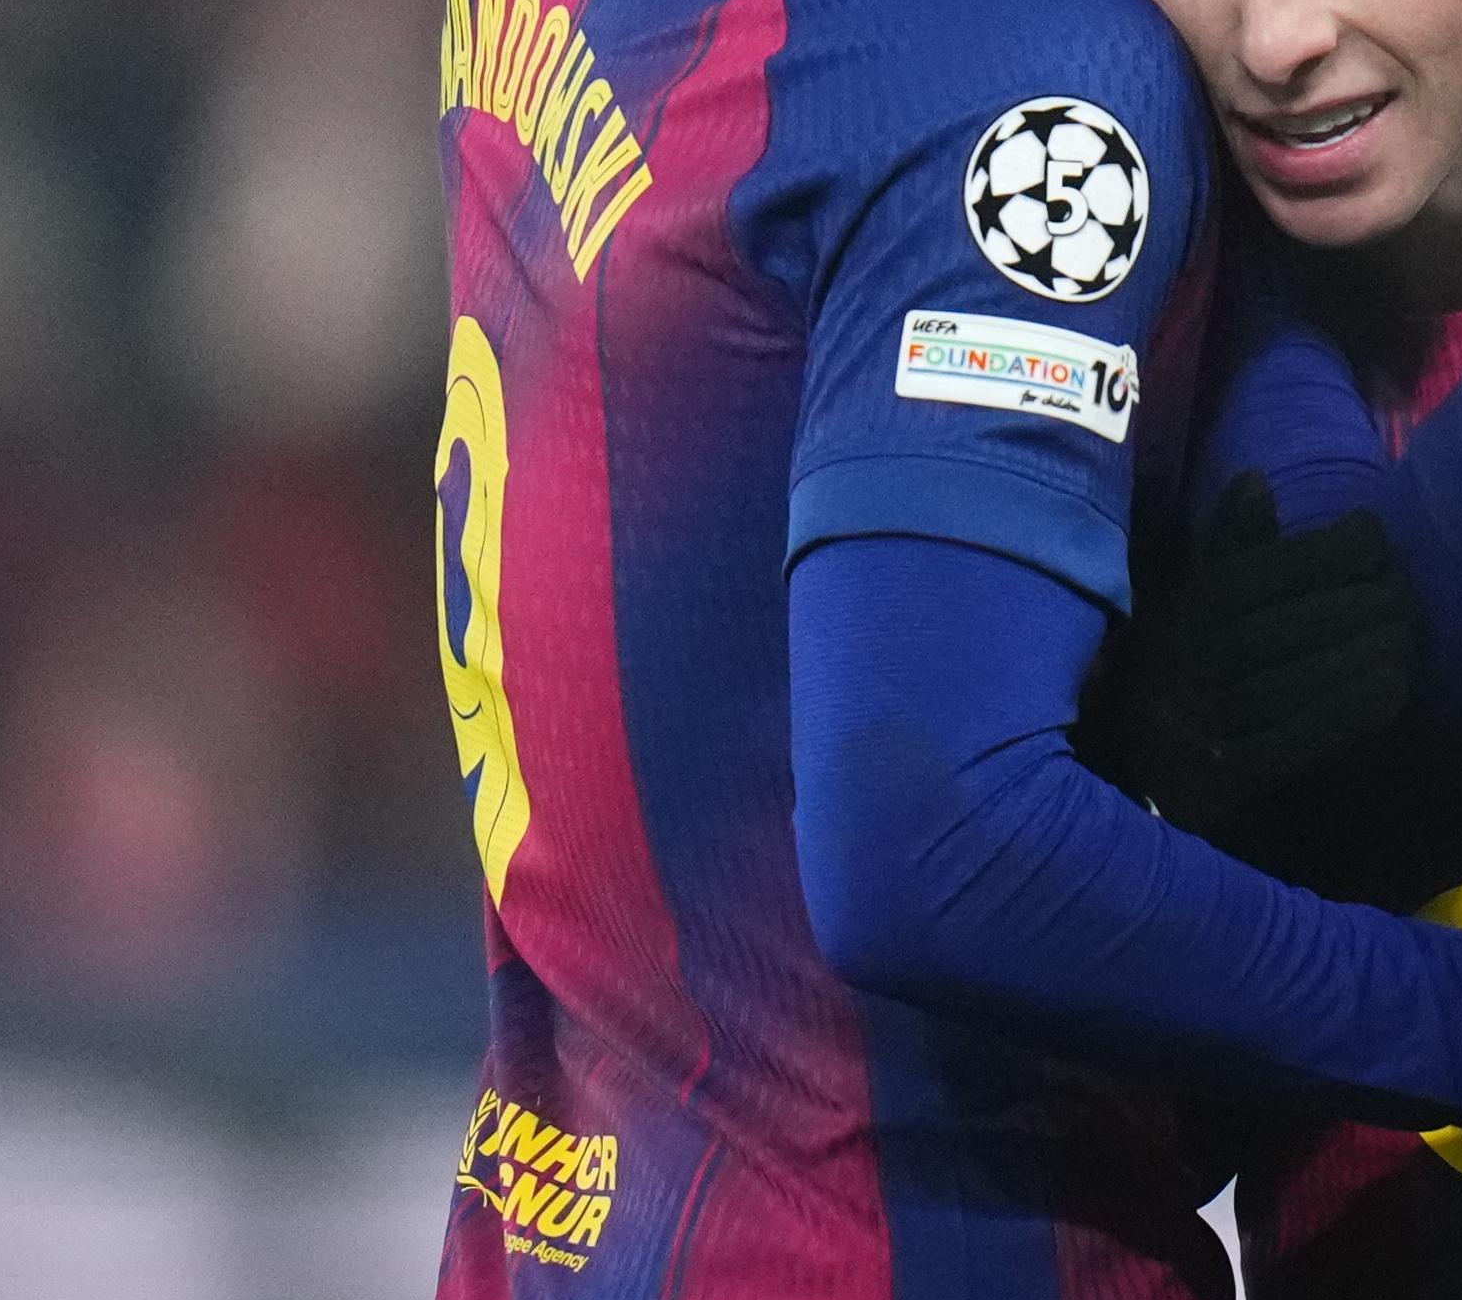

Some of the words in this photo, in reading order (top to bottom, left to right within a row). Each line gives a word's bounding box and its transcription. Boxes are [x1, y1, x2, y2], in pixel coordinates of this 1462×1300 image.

[1045, 160, 1089, 237] 5
[913, 318, 958, 335] UEFA
[908, 344, 1085, 389] FOUNDATION
[435, 315, 531, 910] 9
[530, 1239, 589, 1273] Agency
